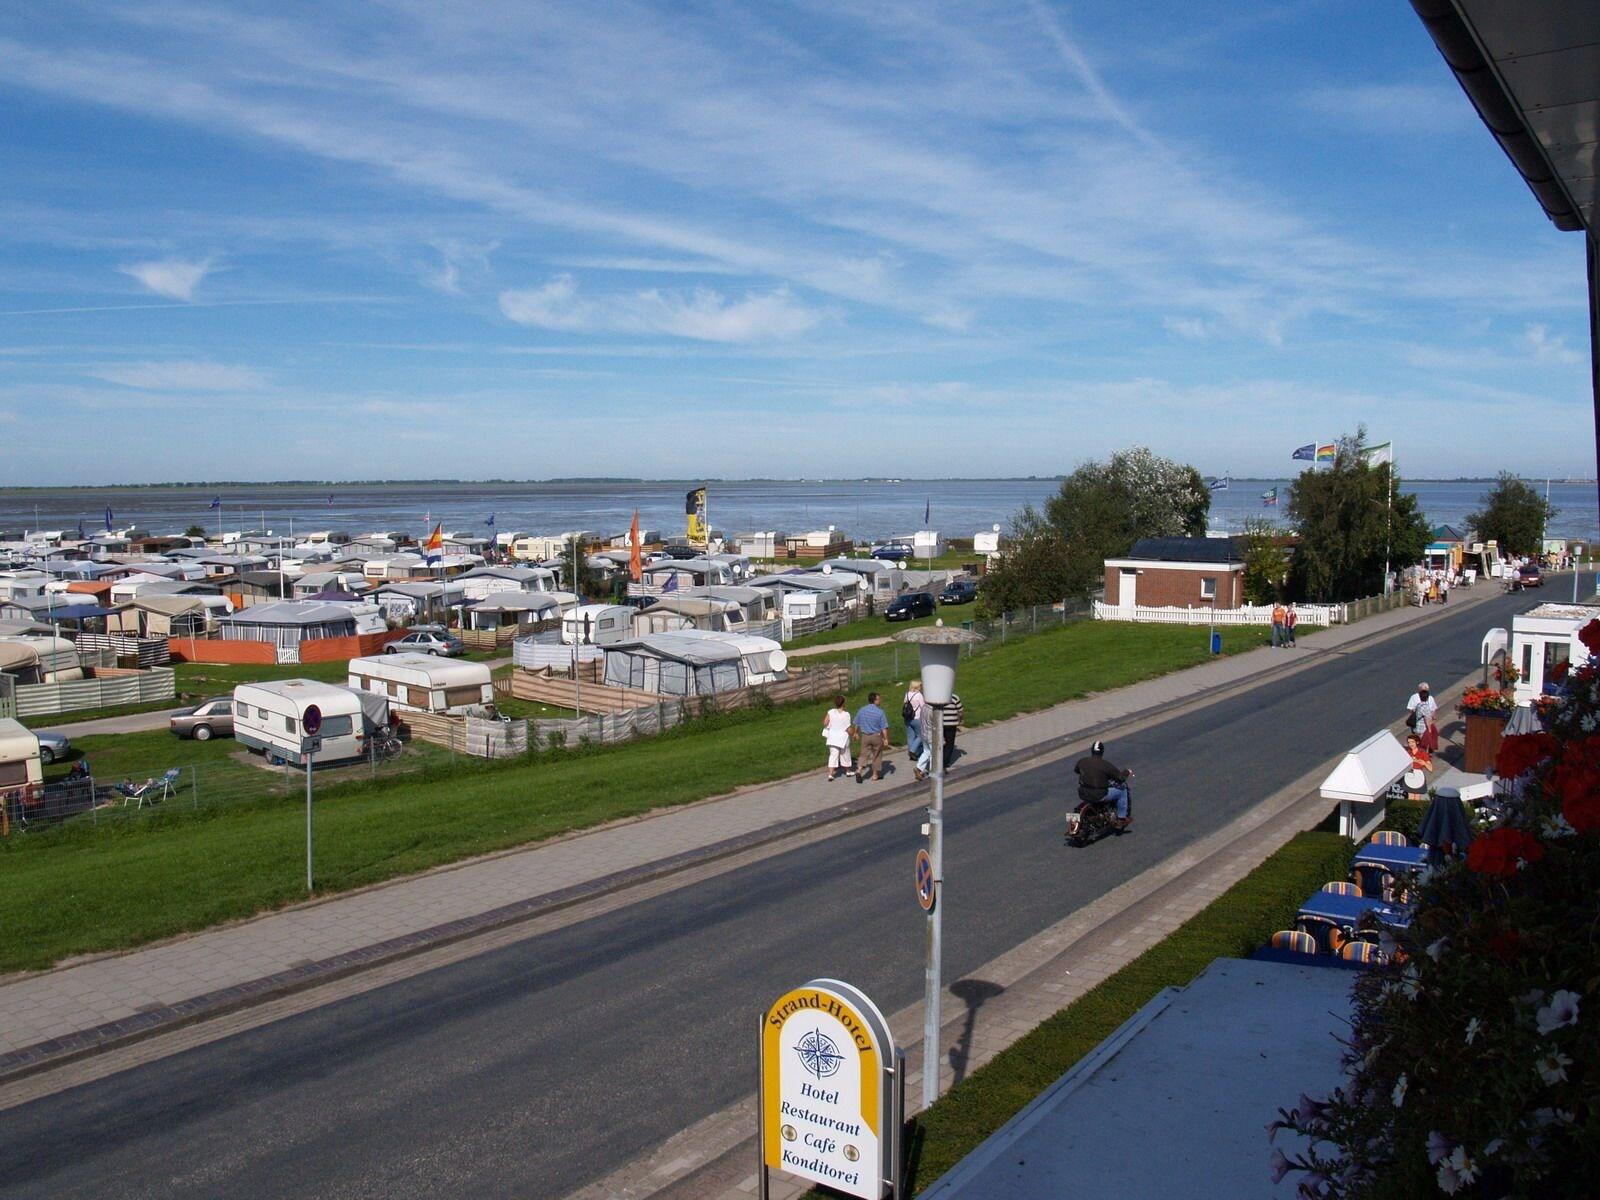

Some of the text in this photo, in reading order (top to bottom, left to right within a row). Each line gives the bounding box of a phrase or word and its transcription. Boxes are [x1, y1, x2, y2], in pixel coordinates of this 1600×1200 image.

[770, 994, 872, 1053] Strand-Hotel
[801, 1083, 839, 1105] Hotel
[781, 1101, 861, 1136] Restaurant
[804, 1132, 836, 1154] Café
[783, 1150, 859, 1185] Konditorei
